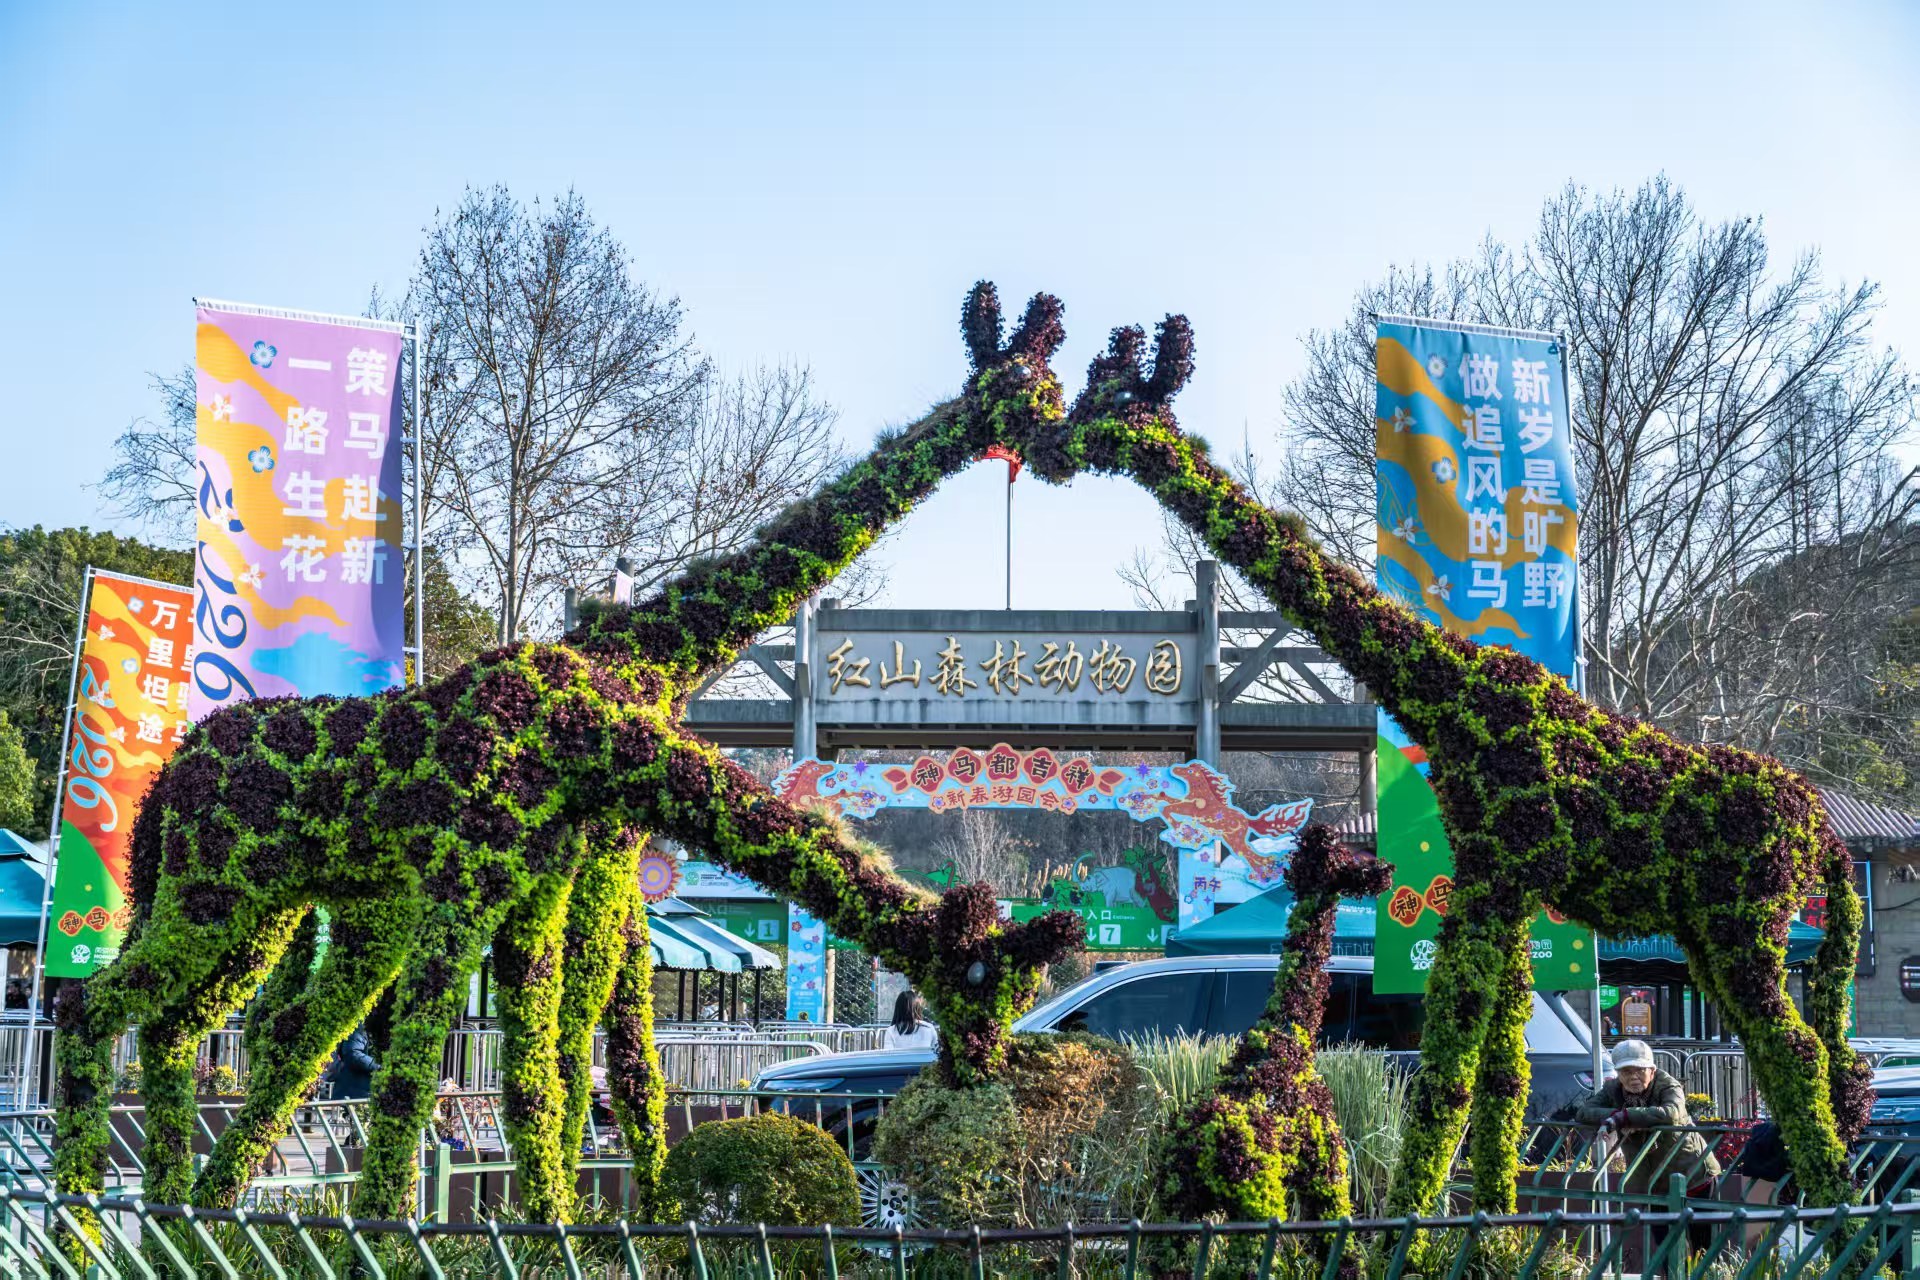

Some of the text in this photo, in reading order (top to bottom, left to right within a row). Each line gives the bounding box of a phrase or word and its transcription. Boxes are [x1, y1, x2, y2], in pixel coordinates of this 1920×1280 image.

[280, 355, 332, 584] 一路生花
[340, 346, 389, 585] 策马赴新
[1459, 352, 1508, 609] 做追风的马
[1511, 356, 1565, 610] 新岁是旷野
[135, 599, 181, 745] 万里坦途
[826, 636, 1182, 696] 红山森林动物园
[914, 753, 1091, 791] 神马都吉祥
[946, 785, 1061, 808] 新春游园会
[1194, 876, 1222, 893] 丙午
[1105, 927, 1116, 942] 7
[1532, 951, 1553, 959] ZOO
